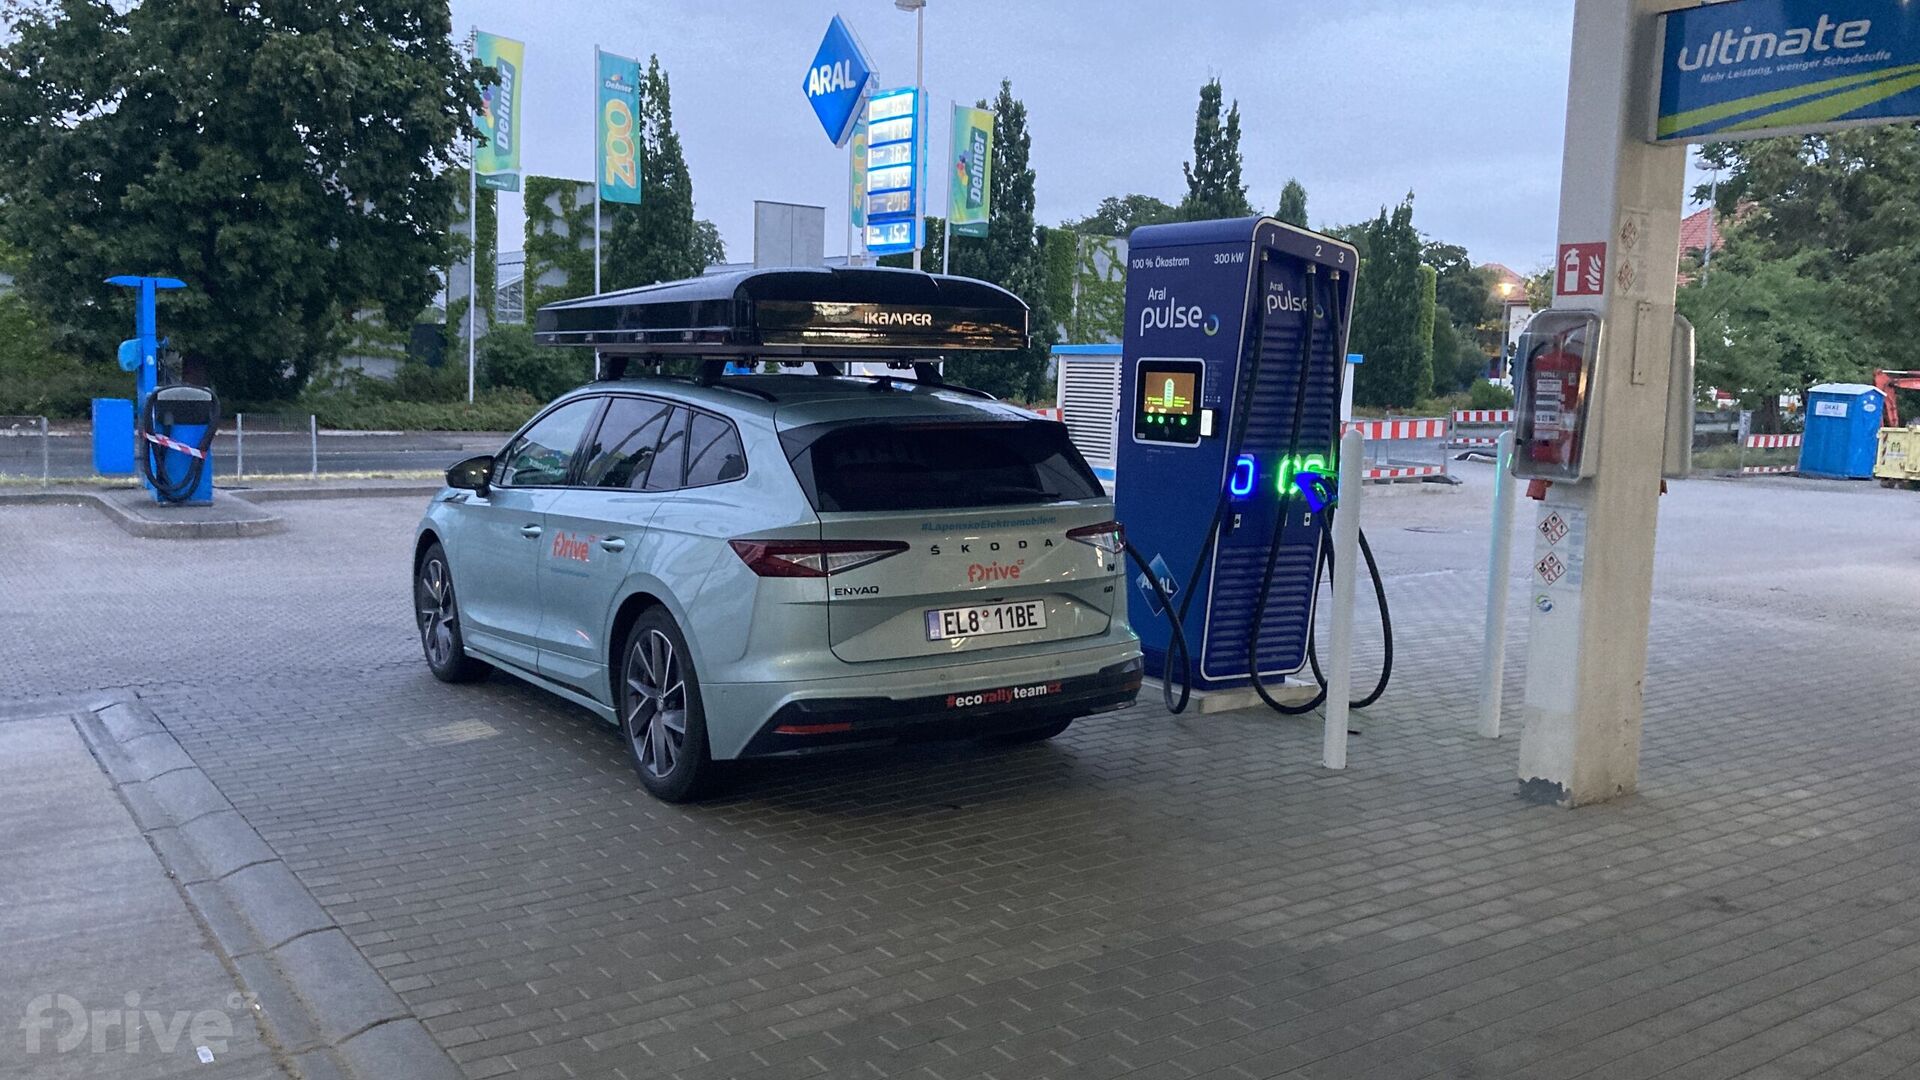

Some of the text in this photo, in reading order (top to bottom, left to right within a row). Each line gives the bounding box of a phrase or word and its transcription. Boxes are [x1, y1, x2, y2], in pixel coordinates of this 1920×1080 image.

[1678, 14, 1872, 72] ultimate
[1700, 50, 1892, 83] Mehr Leistung, weniger Schadstoffe
[604, 80, 633, 93] Dehner
[808, 60, 856, 97] ARAL
[496, 65, 513, 151] Dehner
[605, 98, 637, 189] ZOO
[970, 132, 986, 203] Dehner
[1271, 232, 1276, 246] 1
[1214, 251, 1244, 264] 300 kW
[1314, 244, 1322, 257] 2
[1338, 251, 1345, 264] 3
[1132, 255, 1190, 269] 100 % Ökostrom
[1147, 286, 1167, 301] Aral
[1269, 281, 1284, 291] Aral
[1140, 296, 1203, 337] pulse
[834, 585, 880, 596] ENYAQ
[943, 604, 1038, 636] EL8 11BE
[946, 682, 1062, 708] #ecorallyteamcz
